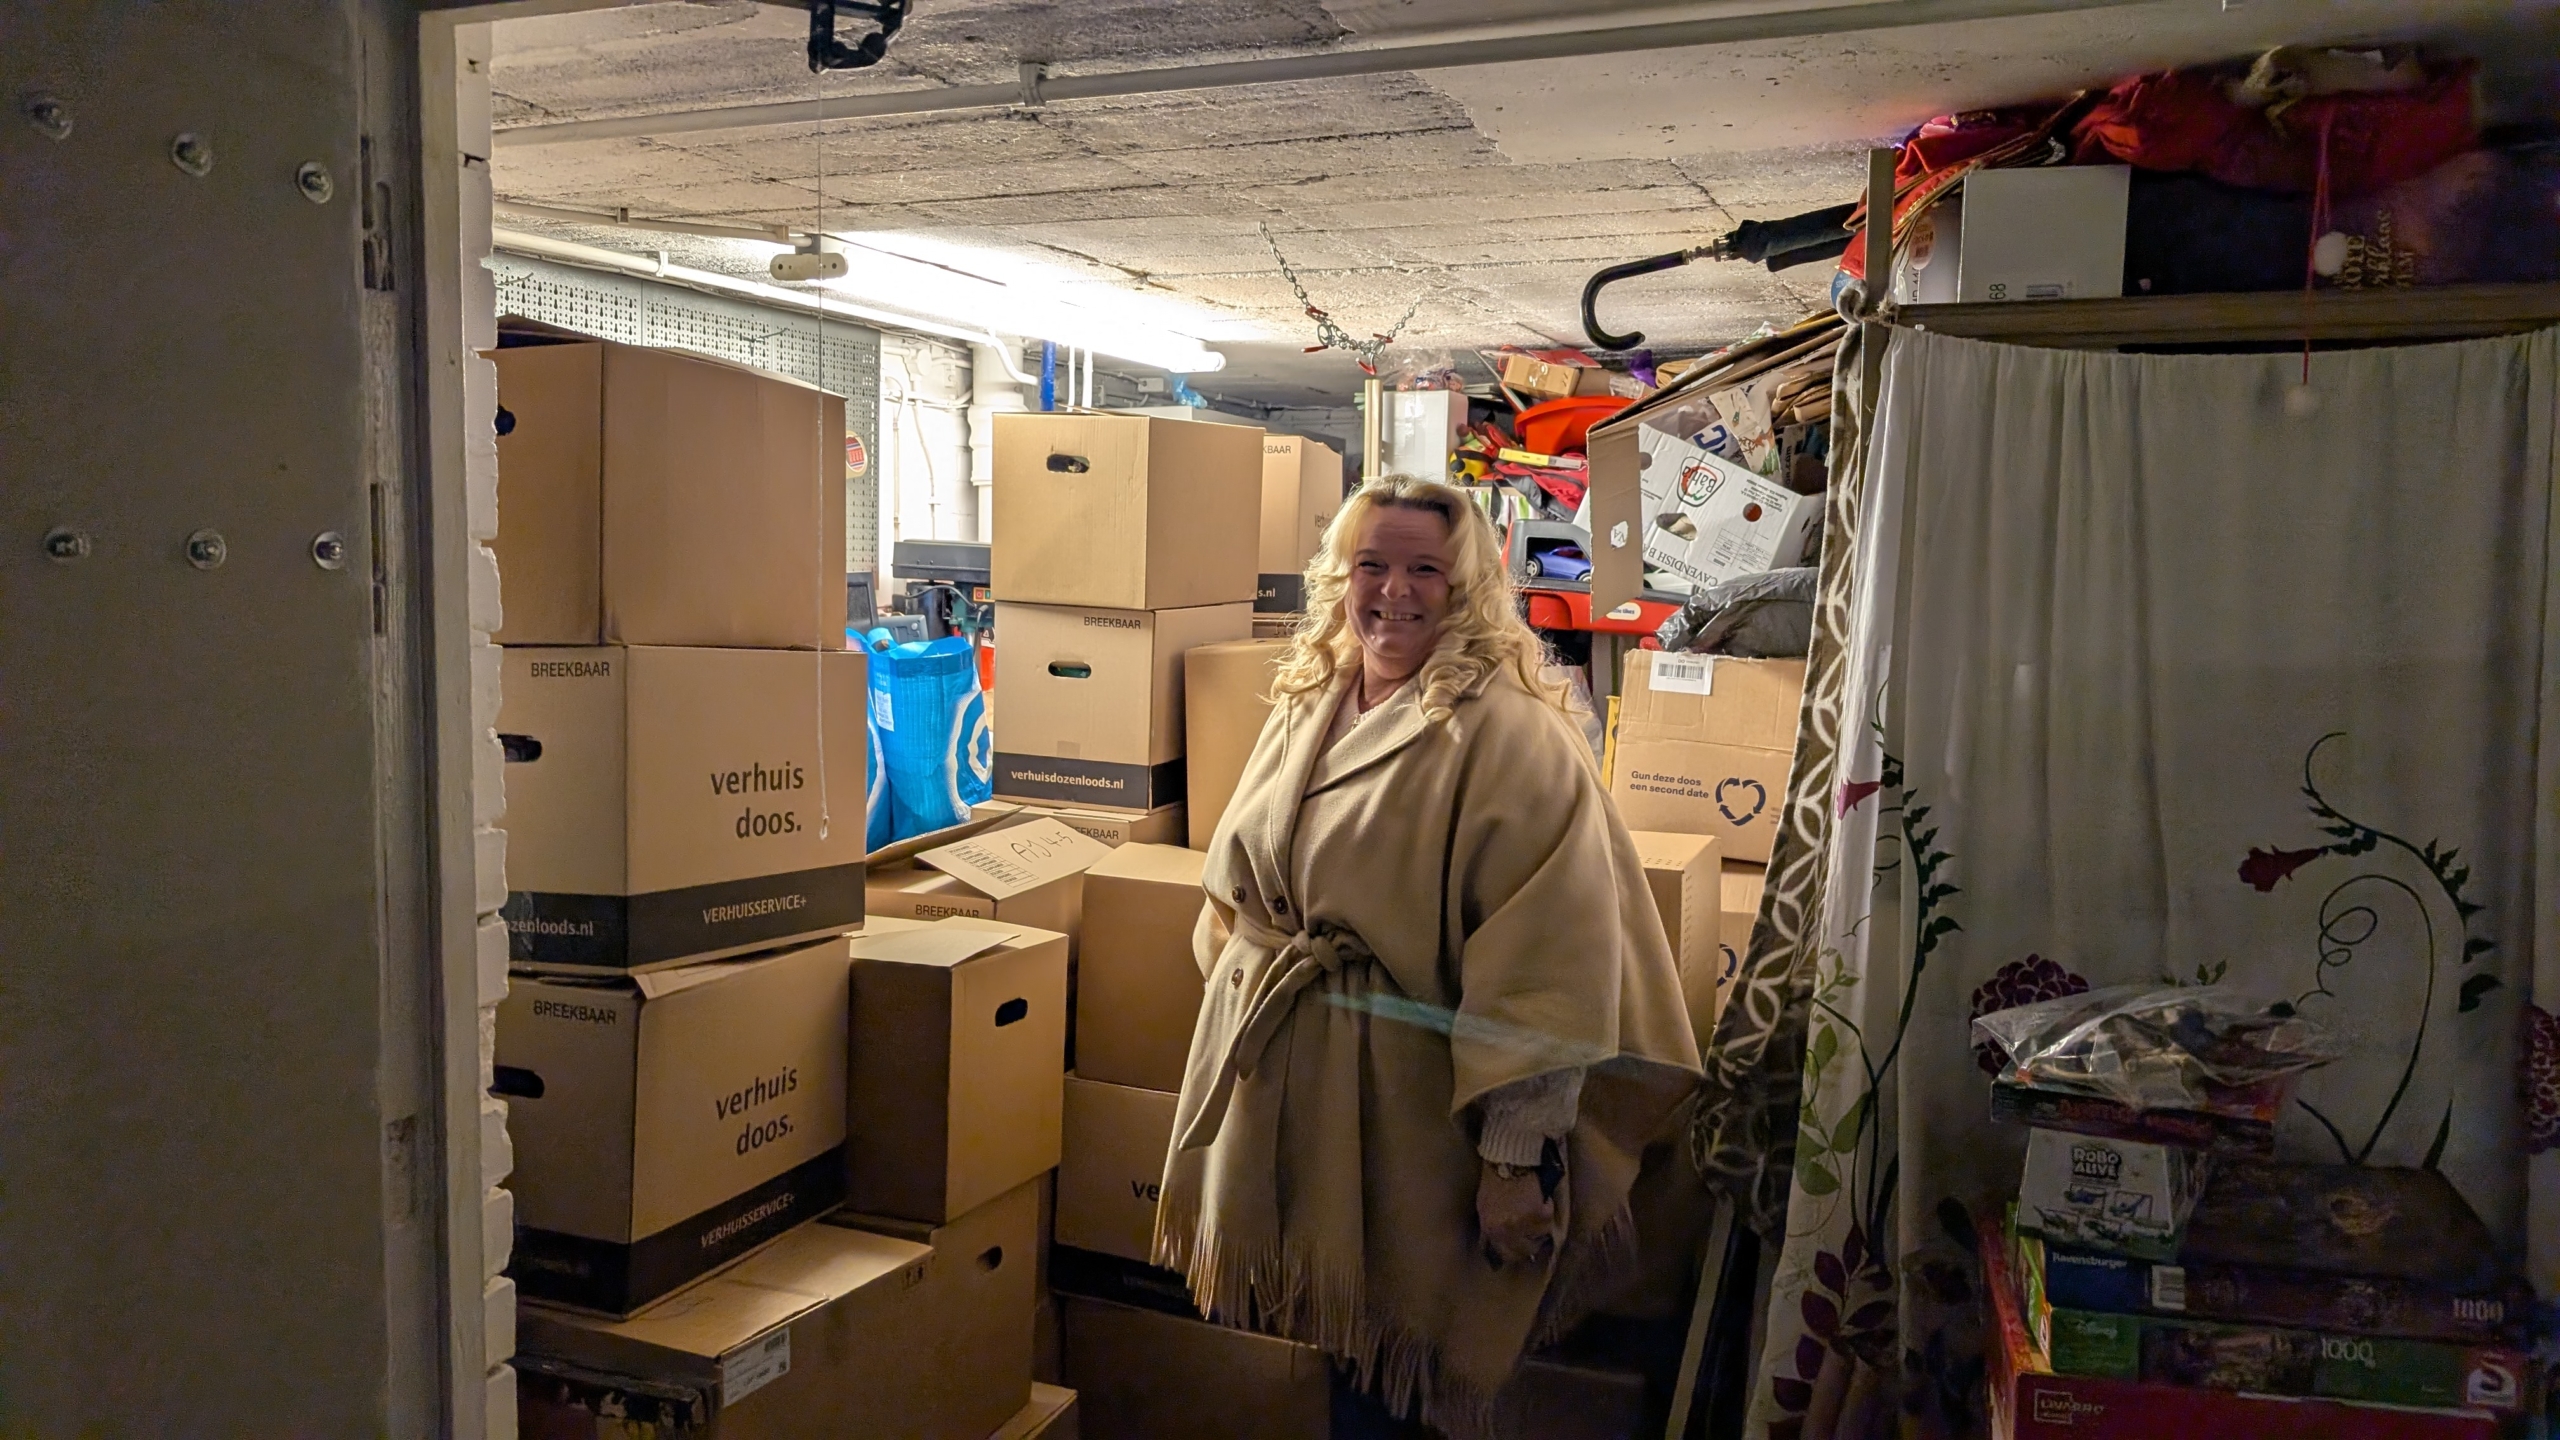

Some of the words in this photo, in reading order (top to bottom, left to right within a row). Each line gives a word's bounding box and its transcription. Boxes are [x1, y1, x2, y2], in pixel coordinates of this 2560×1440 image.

[1263, 445, 1292, 454] KBAAR
[1657, 549, 1718, 587] CAVENDISH
[1258, 587, 1276, 598] s.nl
[1083, 615, 1141, 630] BREEKBAAR
[531, 661, 610, 678] BREEKBAAR
[711, 761, 804, 795] verhuis
[1011, 768, 1124, 790] verhuisdozenloods.nl
[1631, 770, 1651, 781] Gun
[1653, 773, 1675, 784] deze
[1677, 775, 1701, 787] doos
[1630, 783, 1647, 791] een
[1649, 784, 1685, 796] second
[1687, 788, 1709, 799] date
[735, 807, 802, 839] doos.
[703, 894, 807, 924] VERHUISSERVICE+
[915, 904, 979, 918] BREEKBAAR
[507, 917, 594, 936] zenloods.nl
[533, 1000, 616, 1025] BREEKBAAR
[716, 1065, 798, 1121] verhuis
[736, 1111, 794, 1157] doos.
[2072, 1161, 2120, 1180] ALIVE
[1131, 1180, 1160, 1201] ve
[700, 1191, 796, 1249] VERHUISSERVICE+
[2320, 1337, 2374, 1362] 1000
